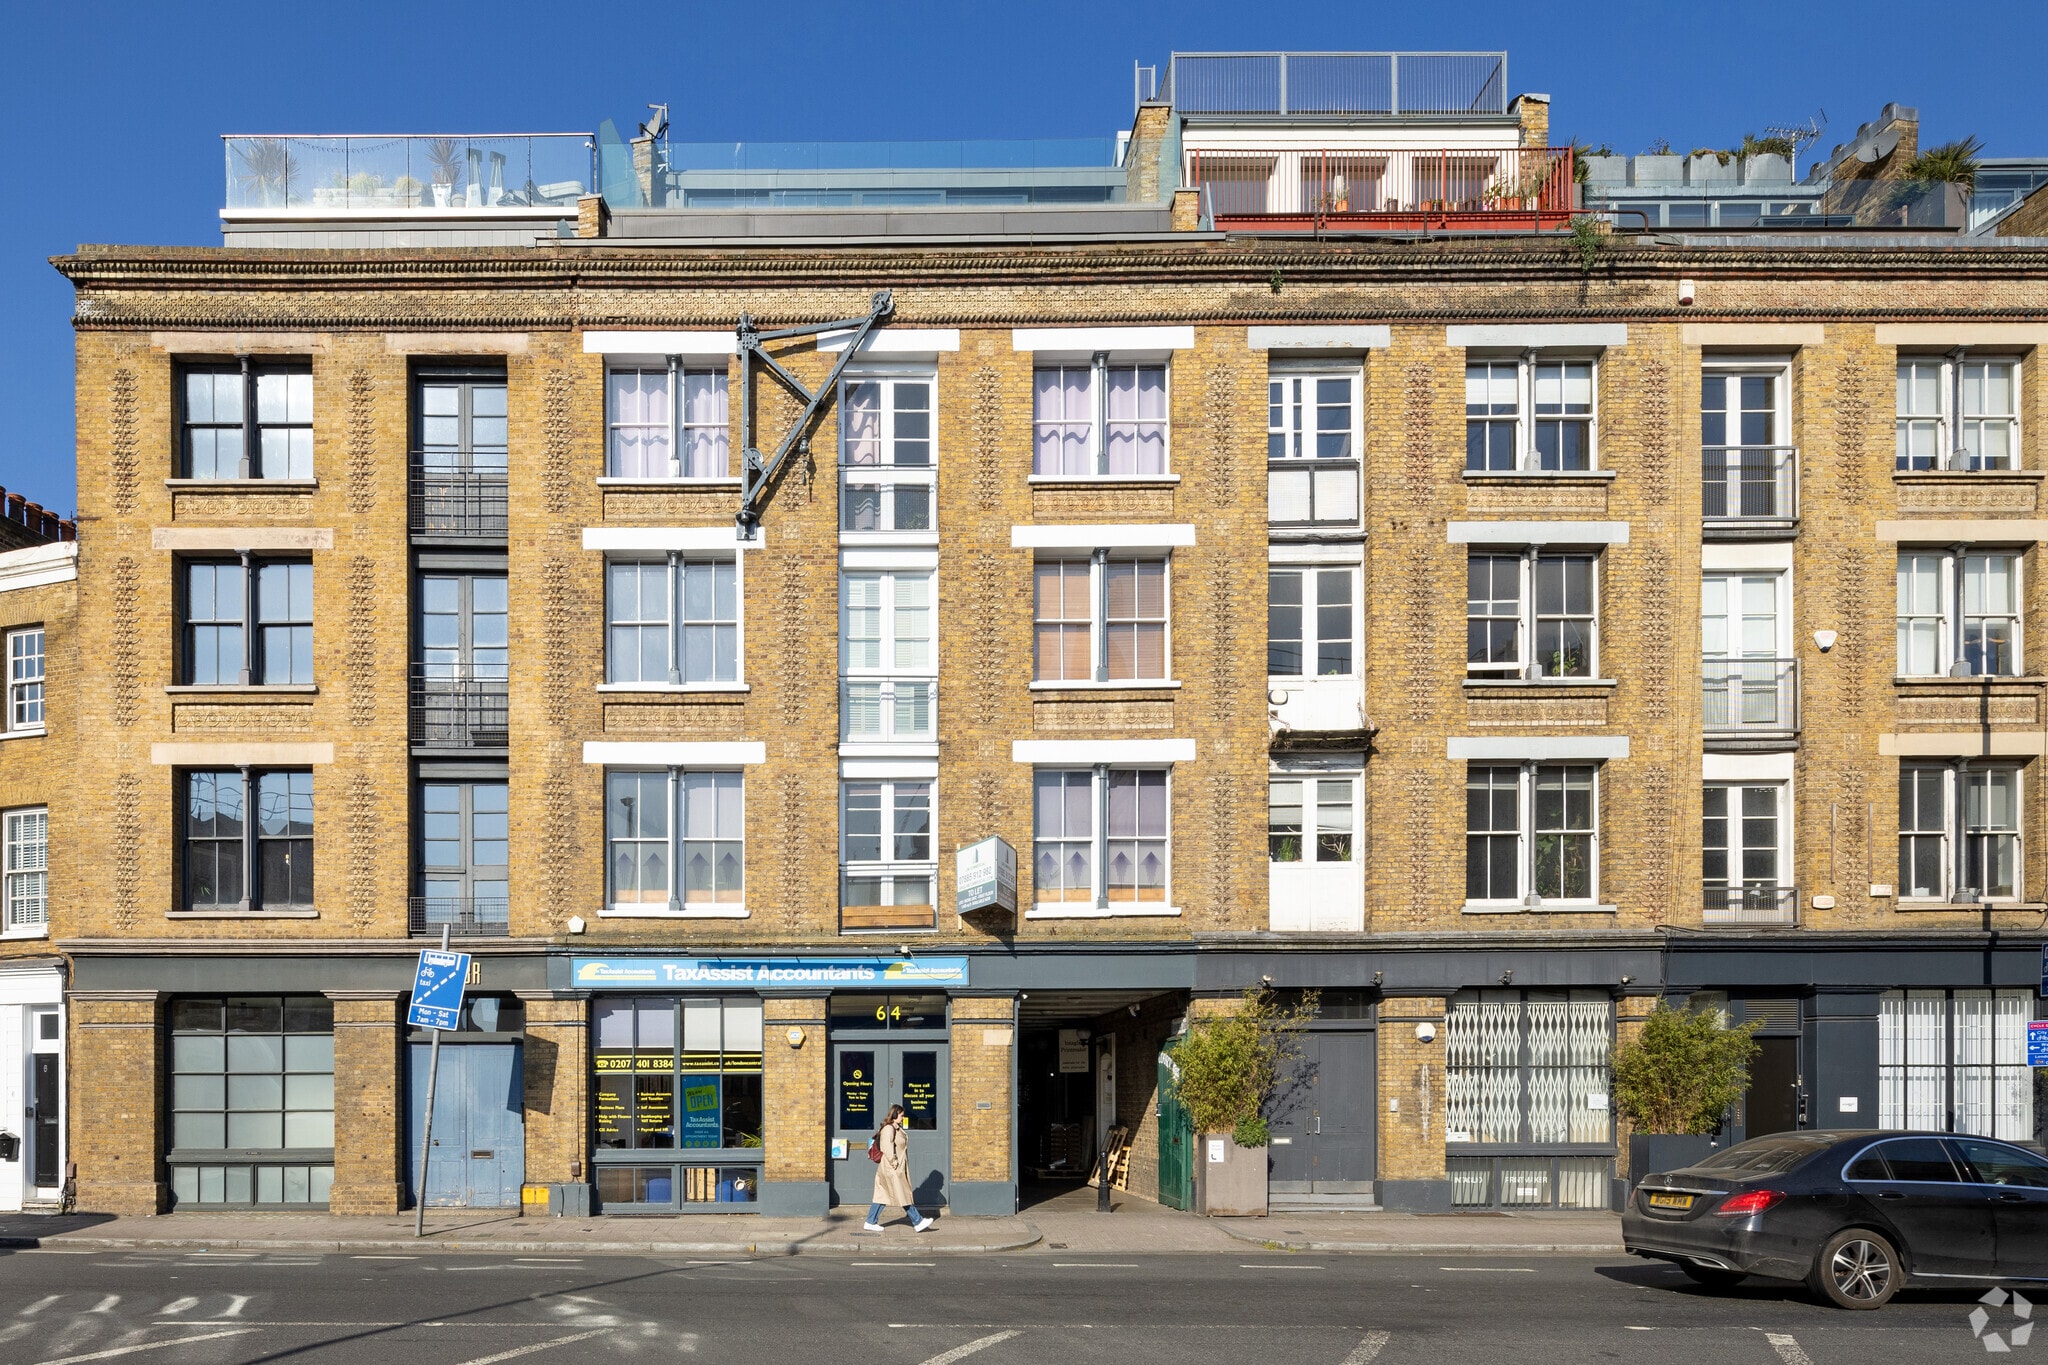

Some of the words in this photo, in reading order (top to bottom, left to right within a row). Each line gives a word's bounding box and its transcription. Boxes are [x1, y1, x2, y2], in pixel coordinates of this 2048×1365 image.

[975, 886, 983, 895] LET
[662, 964, 753, 981] TaxAssist
[756, 964, 875, 981] Accountants
[418, 1007, 432, 1015] Mon
[437, 1010, 449, 1018] Sat
[876, 1005, 901, 1020] 64
[416, 1015, 429, 1023] 7am
[435, 1018, 449, 1027] 7pm
[610, 1059, 631, 1069] 0207
[636, 1059, 650, 1068] 401
[653, 1059, 674, 1068] 8384
[690, 1093, 714, 1109] OPEN
